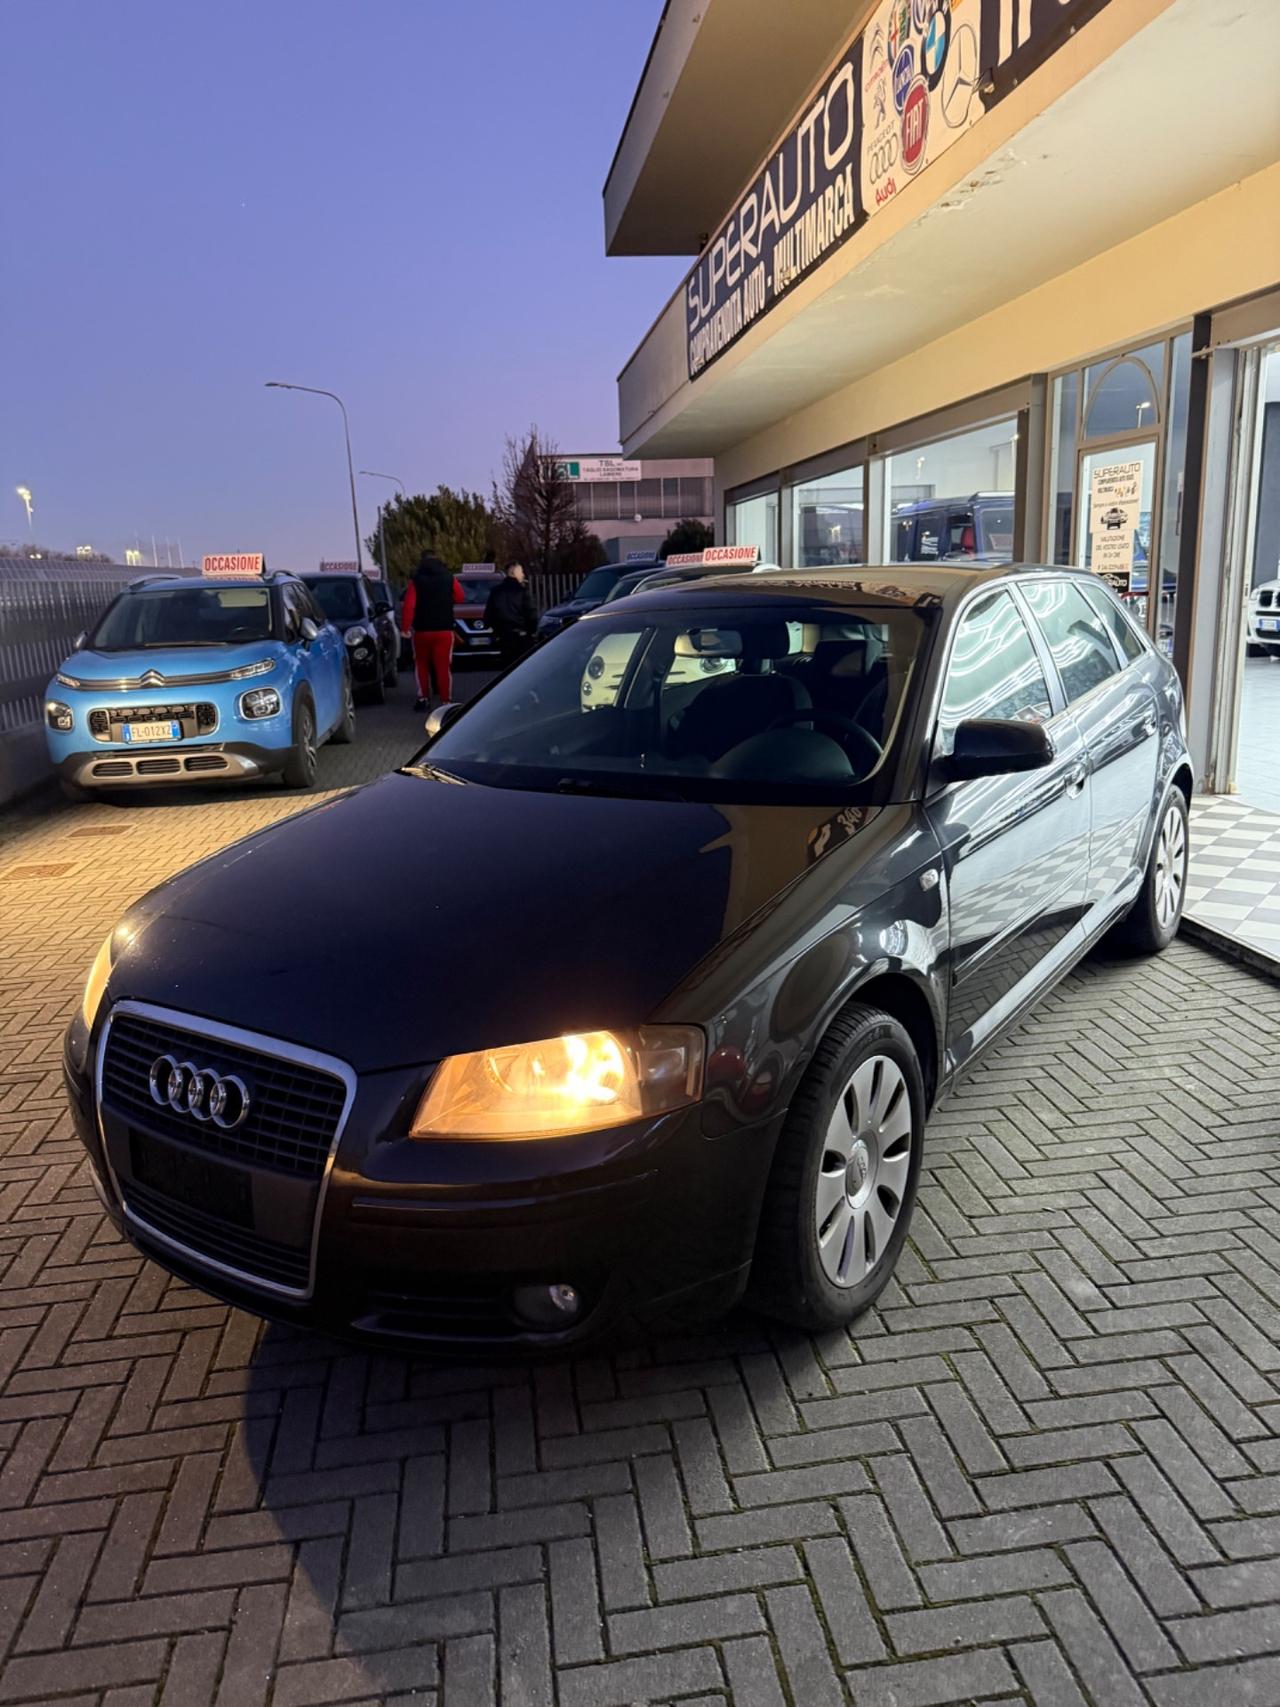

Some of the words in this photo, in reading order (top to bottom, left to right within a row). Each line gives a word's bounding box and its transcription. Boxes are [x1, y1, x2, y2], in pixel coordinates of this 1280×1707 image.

[905, 98, 923, 150] FIAT
[689, 61, 854, 333] SUPERAUTO
[875, 178, 897, 206] Audi
[743, 260, 765, 326] AUTO
[773, 162, 855, 296] MULTIMARCA
[204, 555, 261, 572] OCCASIONE
[705, 547, 757, 561] OCCASIONE
